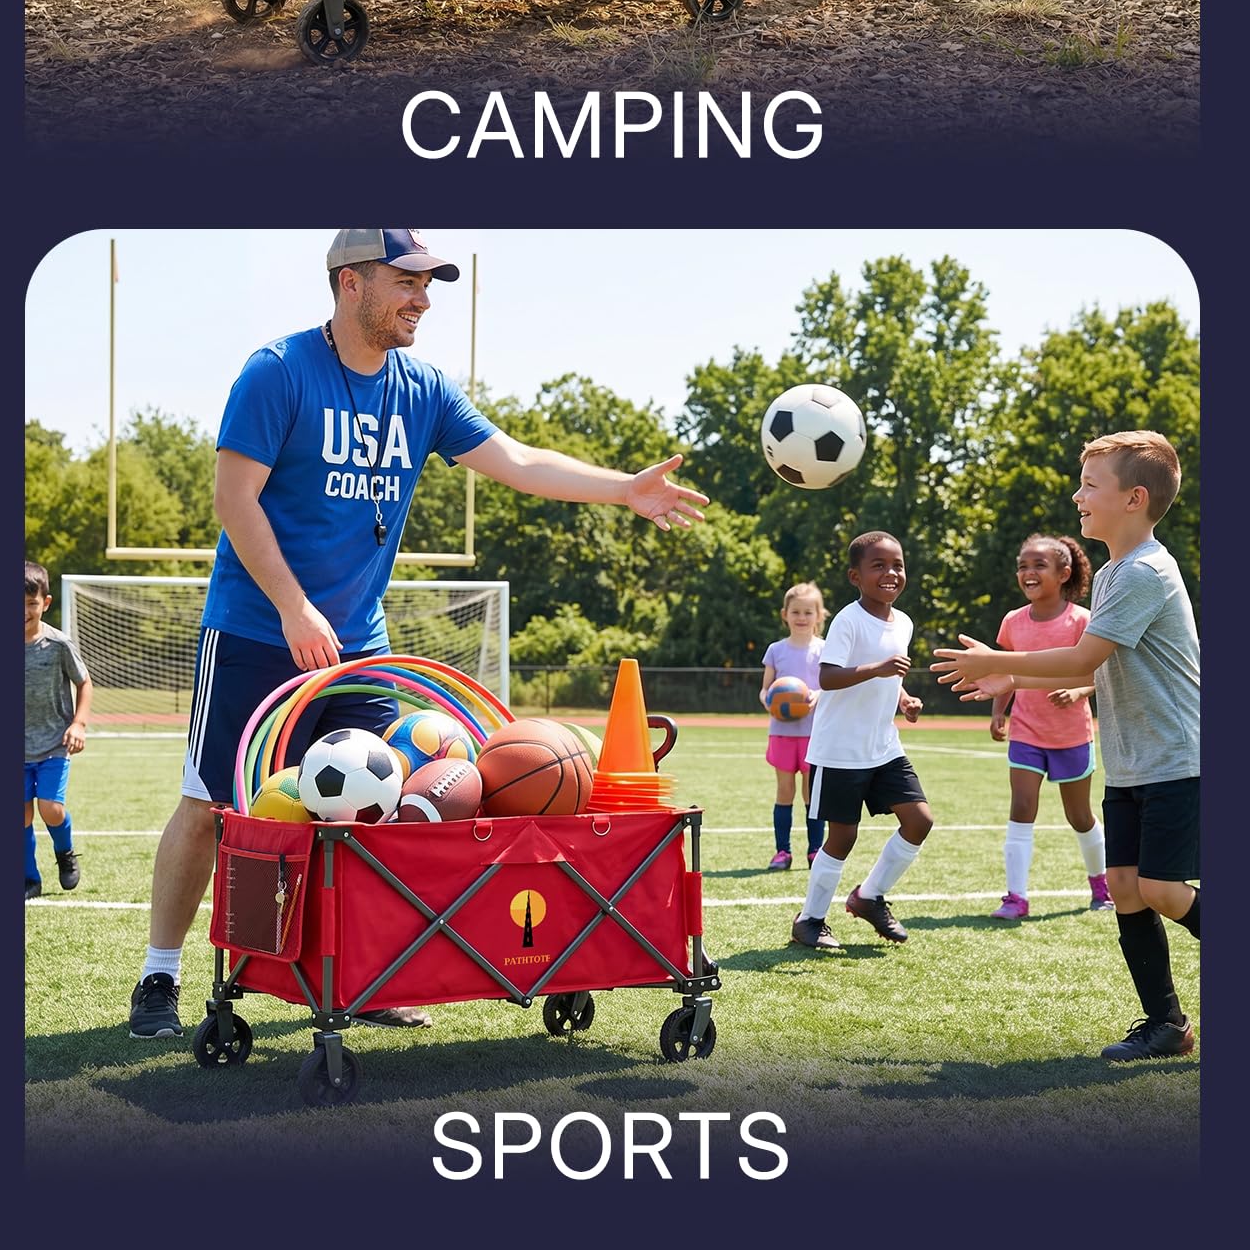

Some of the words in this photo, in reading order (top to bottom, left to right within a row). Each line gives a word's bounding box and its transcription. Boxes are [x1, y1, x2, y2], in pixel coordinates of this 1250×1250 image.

[321, 408, 413, 469] USA
[325, 471, 400, 501] COACH
[503, 954, 551, 966] PATHTOTE
